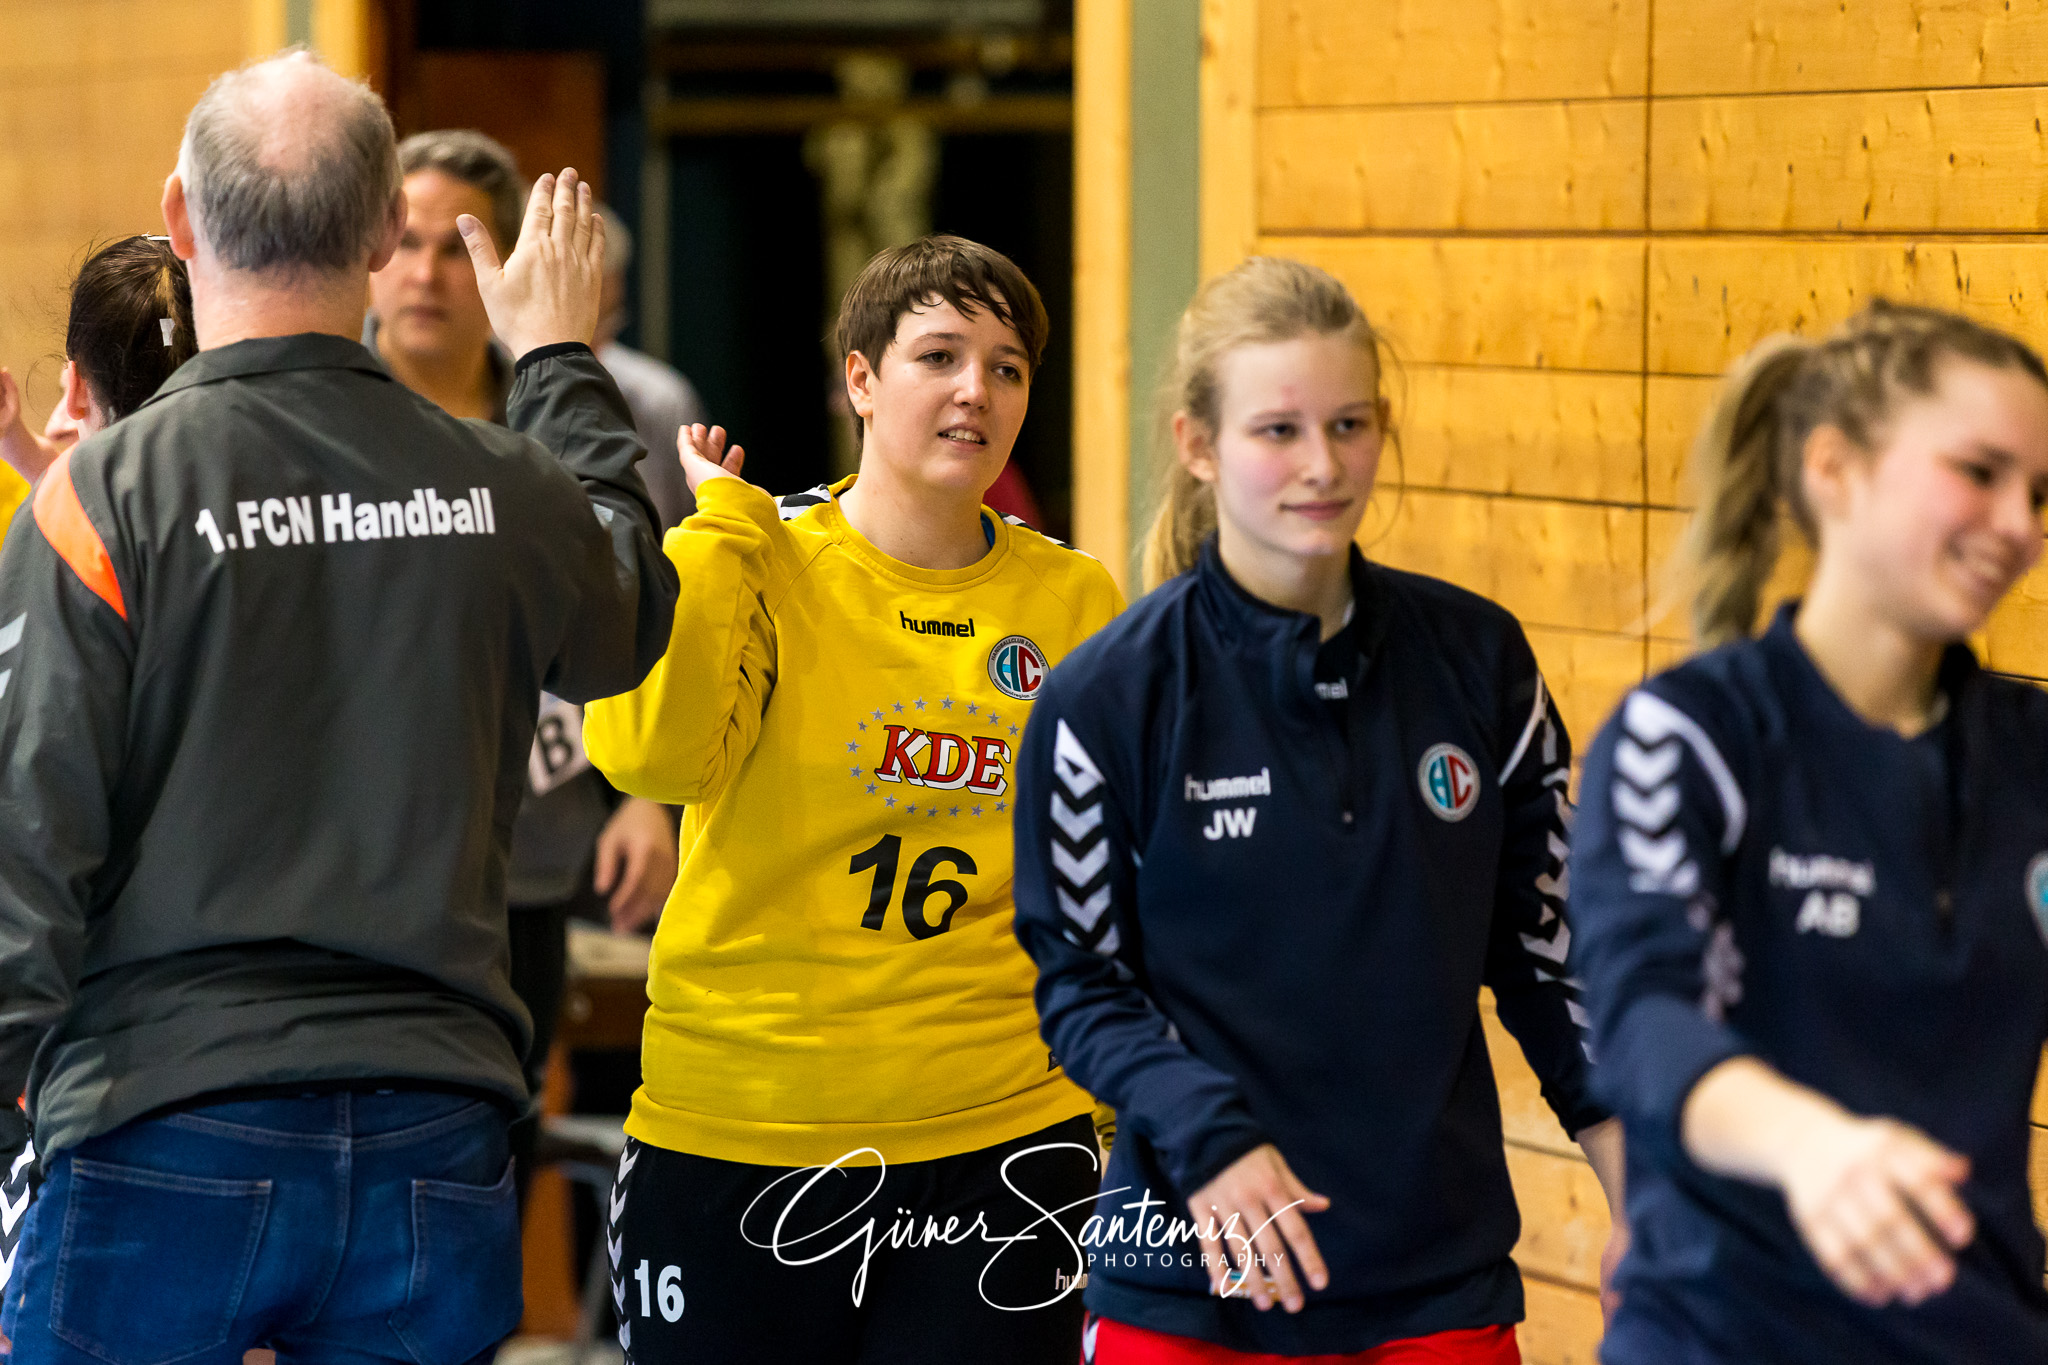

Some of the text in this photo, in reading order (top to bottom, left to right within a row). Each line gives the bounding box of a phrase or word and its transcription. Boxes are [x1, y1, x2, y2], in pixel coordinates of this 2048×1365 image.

[321, 488, 496, 544] Handball
[900, 611, 976, 638] hummel
[537, 716, 573, 774] B
[875, 724, 1012, 797] KDE
[1184, 766, 1271, 801] hummel
[1203, 807, 1257, 840] JW
[848, 833, 978, 941] 16
[1796, 891, 1860, 938] AB
[634, 1259, 685, 1323] 16
[1055, 1268, 1089, 1291] hum
